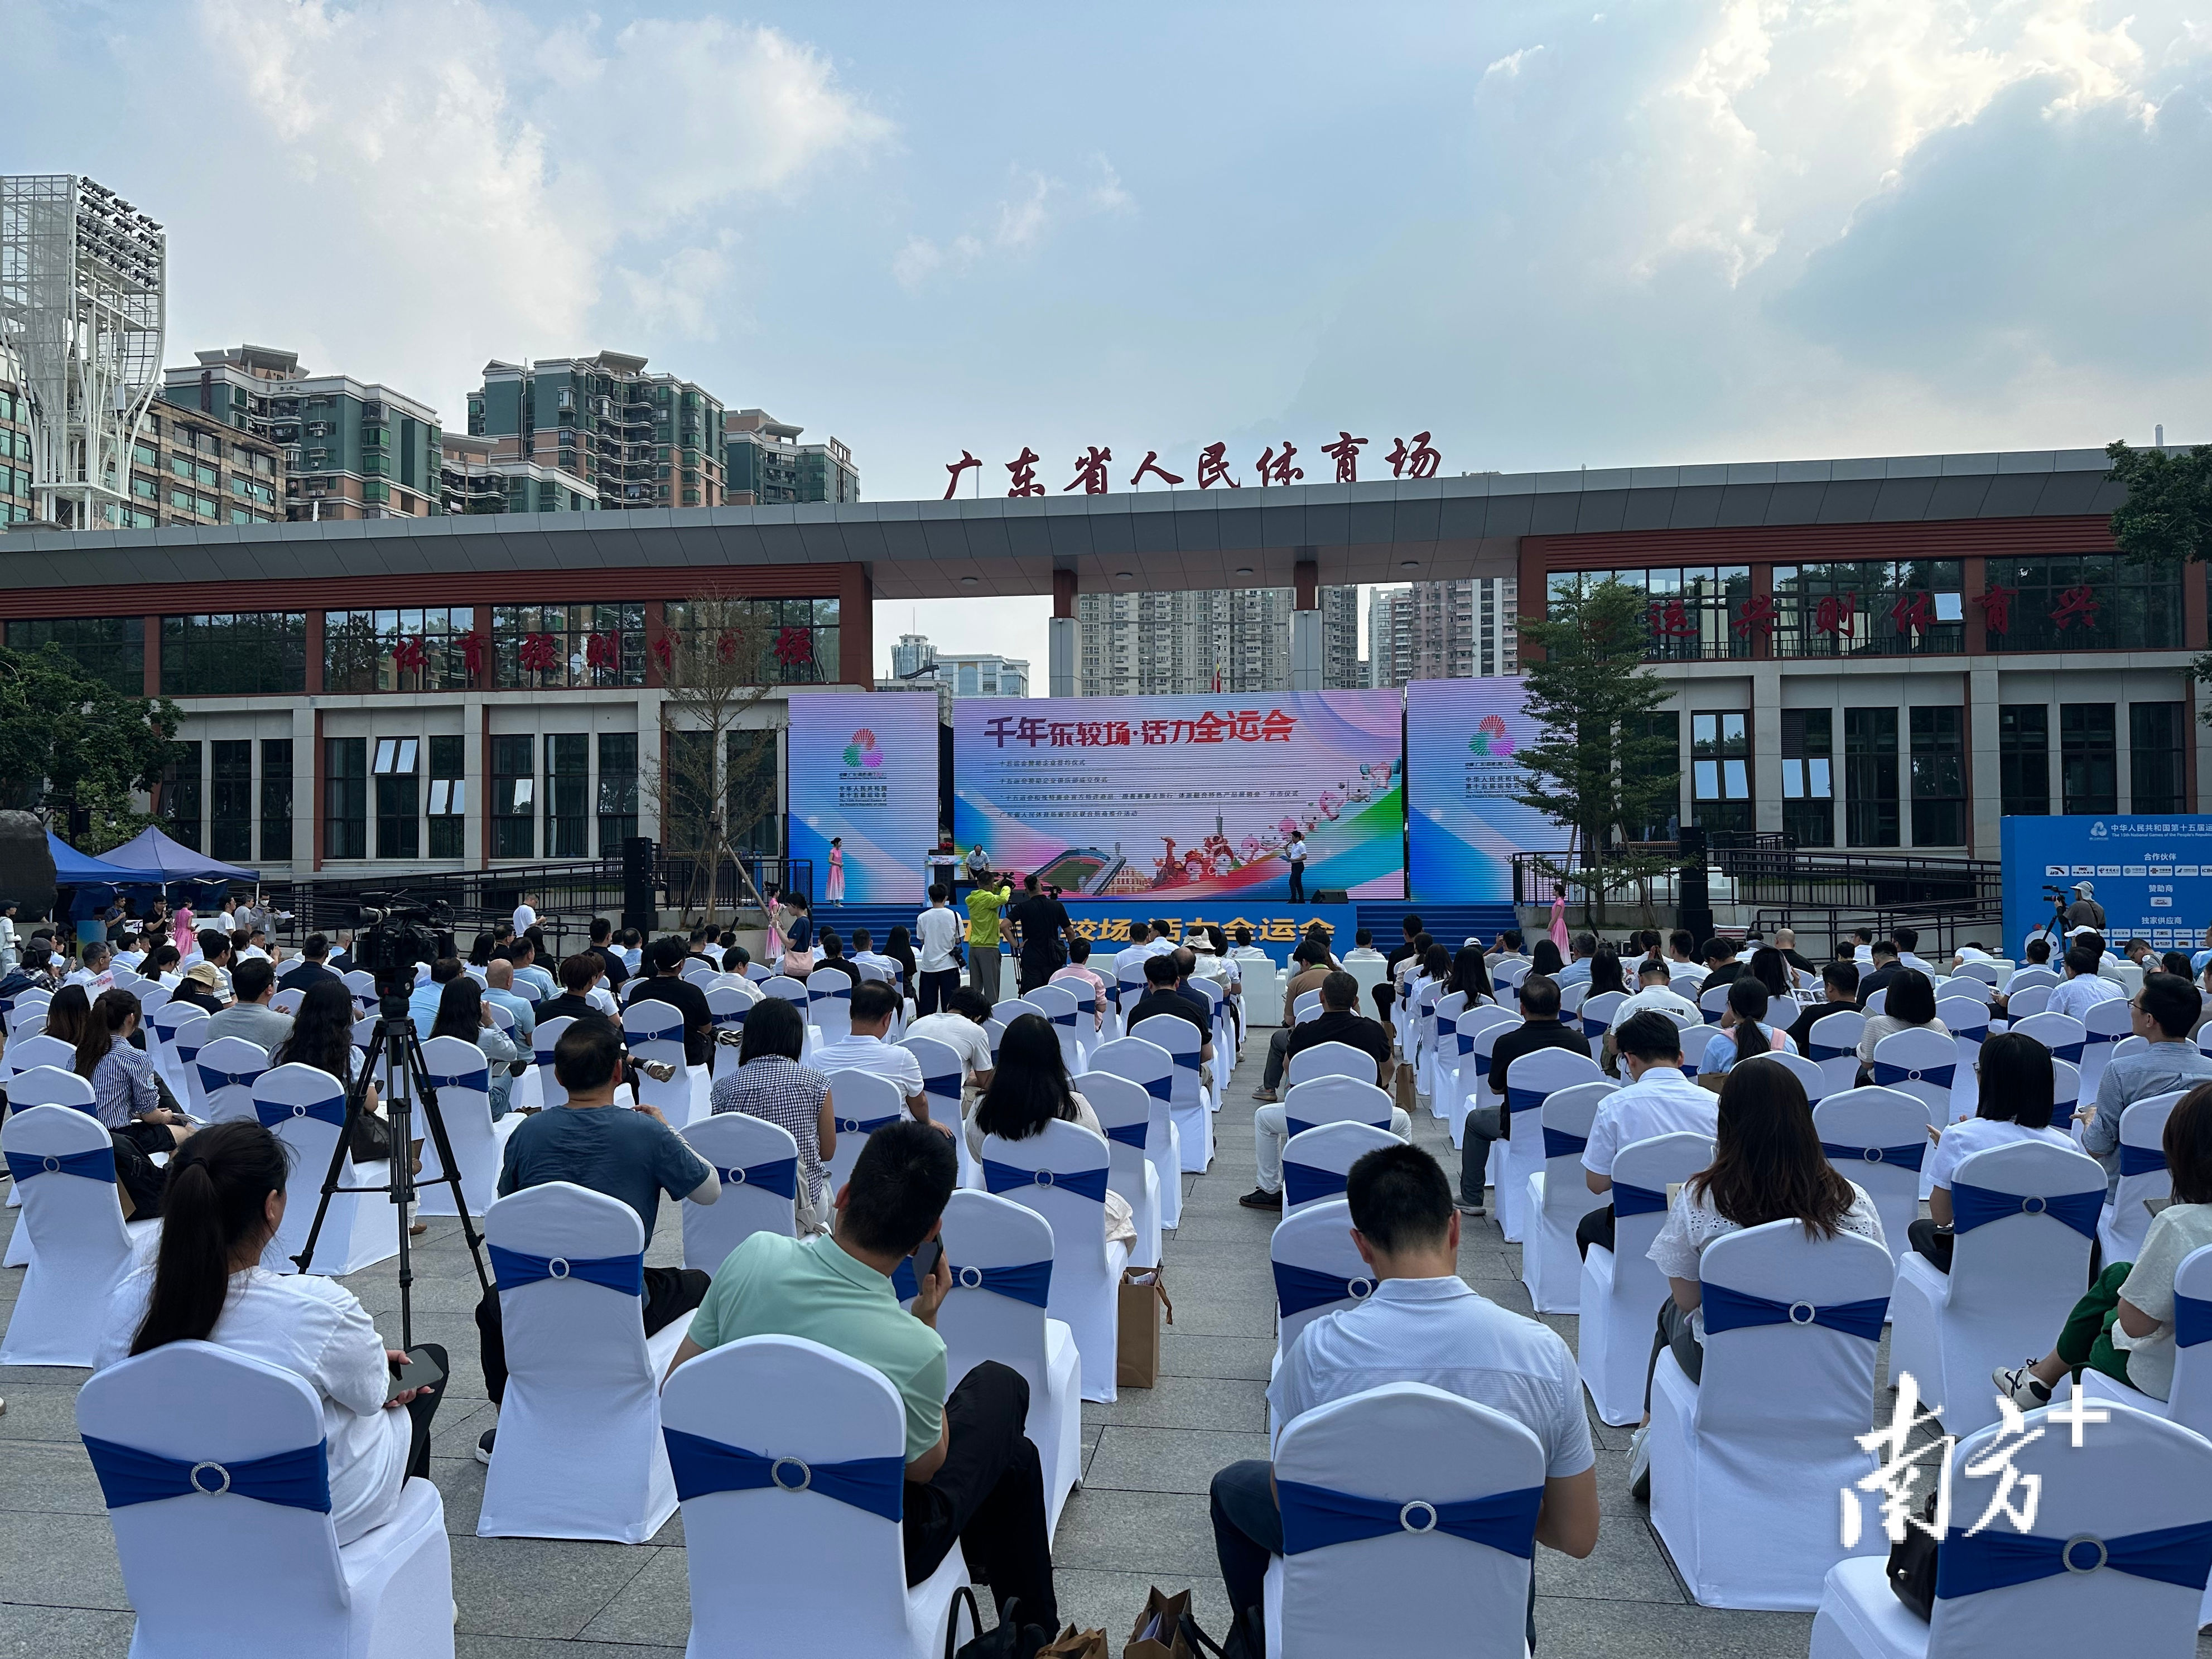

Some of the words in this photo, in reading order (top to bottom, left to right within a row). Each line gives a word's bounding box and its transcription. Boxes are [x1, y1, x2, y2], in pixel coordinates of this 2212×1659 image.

[943, 431, 1441, 500] 广东省人民体育场
[984, 709, 1299, 747] 千年东较场·活力全运会
